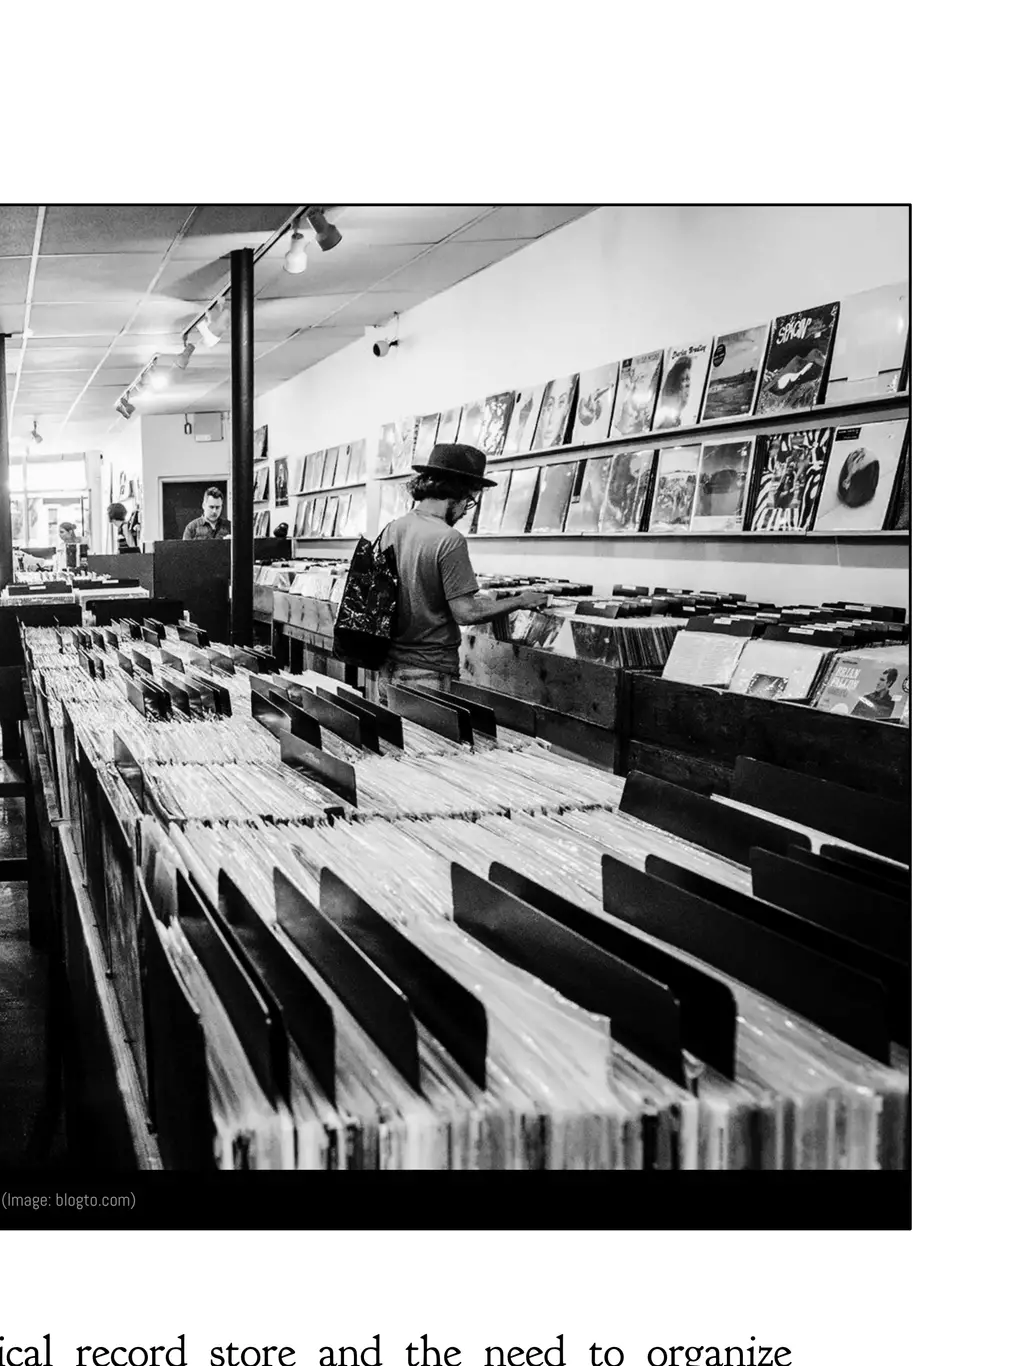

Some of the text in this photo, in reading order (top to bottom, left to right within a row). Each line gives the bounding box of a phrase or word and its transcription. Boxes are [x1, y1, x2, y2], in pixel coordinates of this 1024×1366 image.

[835, 666, 862, 679] BRIAN
[211, 1343, 296, 1366] store
[406, 1334, 461, 1366] the
